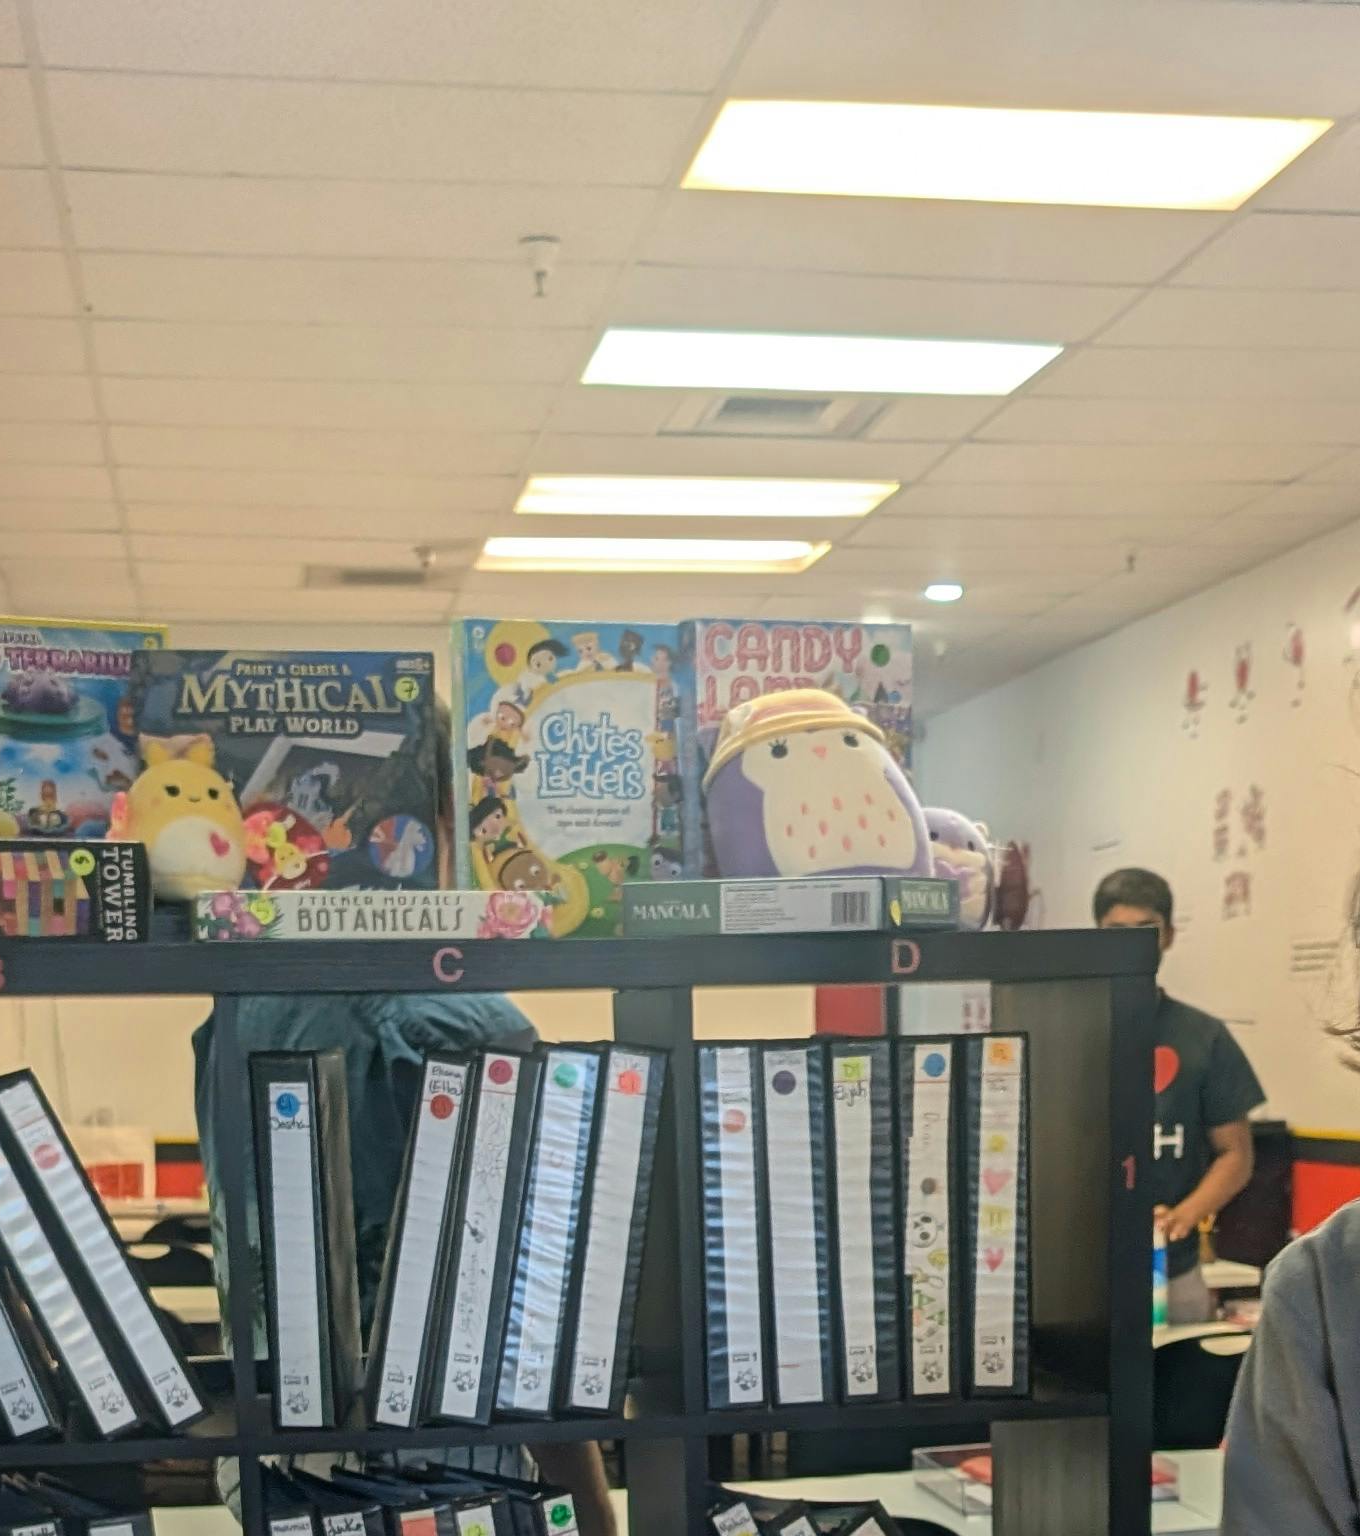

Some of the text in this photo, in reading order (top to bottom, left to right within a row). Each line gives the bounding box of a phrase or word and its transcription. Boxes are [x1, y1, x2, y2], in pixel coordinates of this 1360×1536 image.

[704, 622, 863, 674] CANDY
[236, 662, 274, 677] PAINT
[696, 674, 817, 723] LA
[229, 715, 360, 735] PLAY WORLD
[539, 708, 645, 763] Chutes
[534, 751, 646, 800] Ladders
[101, 845, 125, 943] TOWER
[120, 846, 139, 942] TUMBLING
[297, 894, 462, 906] STICKER MOSAICS
[631, 902, 713, 922] MANCALA
[297, 907, 465, 933] BOTANICALS
[431, 946, 466, 984] C
[890, 938, 921, 976] D
[1121, 1154, 1137, 1190] 1
